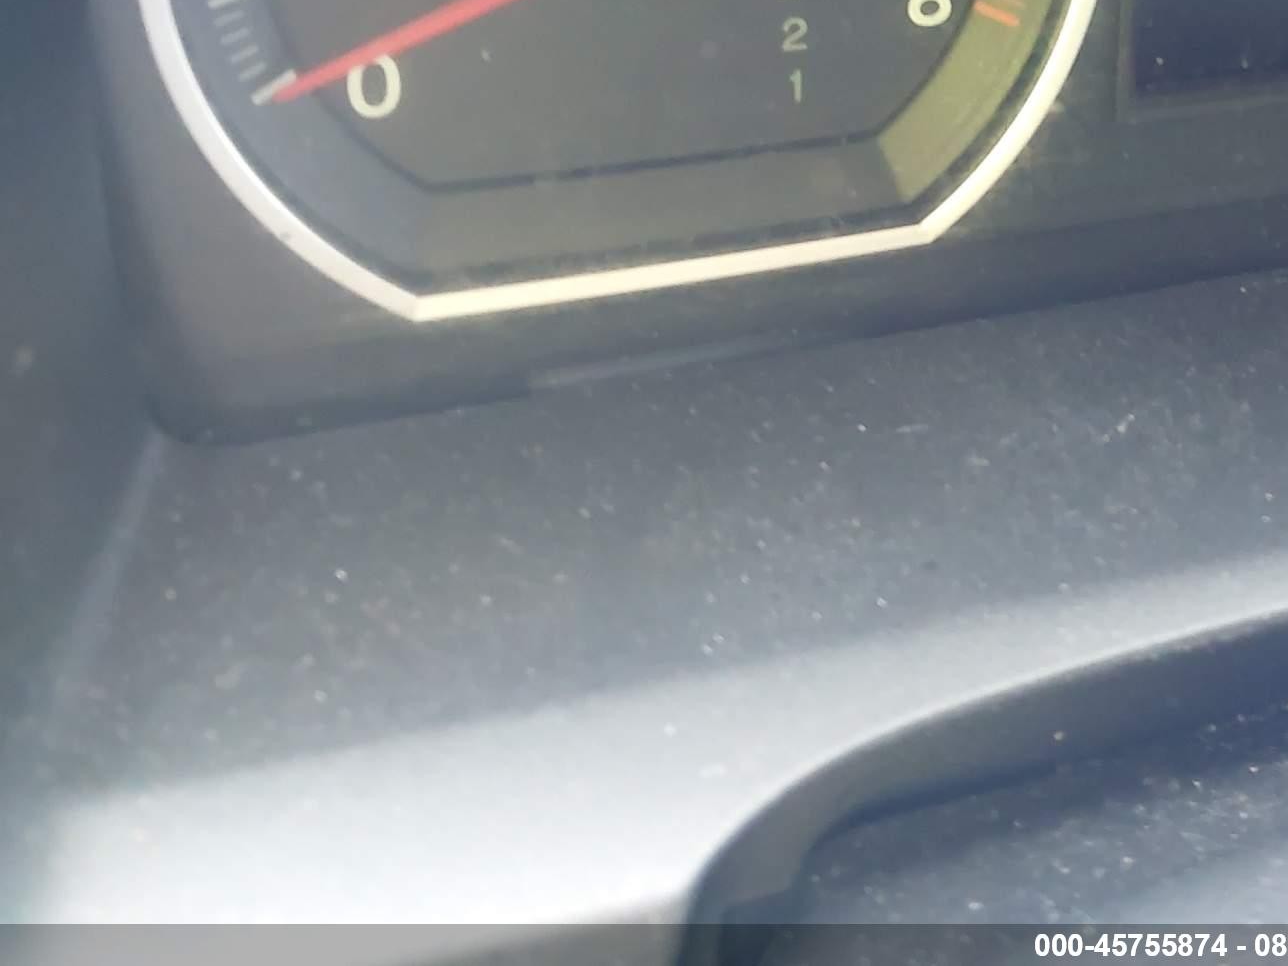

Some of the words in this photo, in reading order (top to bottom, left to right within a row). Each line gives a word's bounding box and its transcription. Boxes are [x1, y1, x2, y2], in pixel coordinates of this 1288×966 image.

[781, 17, 808, 52] 2
[346, 54, 401, 118] 0
[790, 69, 802, 103] 1
